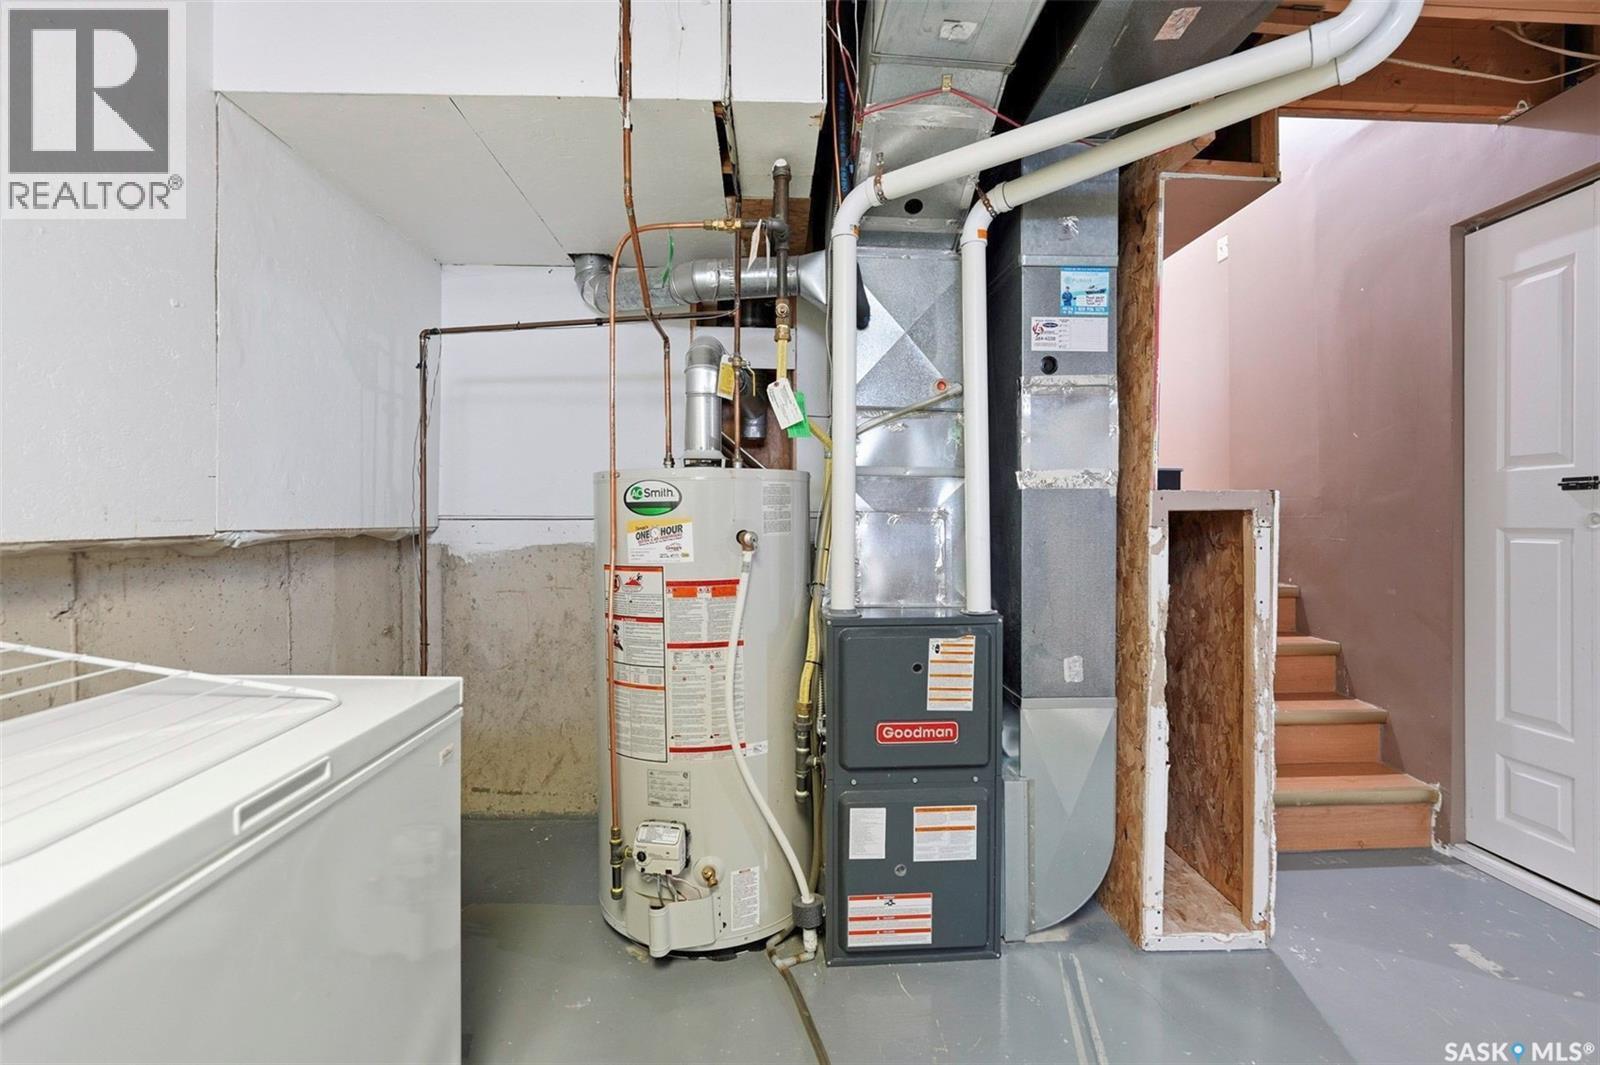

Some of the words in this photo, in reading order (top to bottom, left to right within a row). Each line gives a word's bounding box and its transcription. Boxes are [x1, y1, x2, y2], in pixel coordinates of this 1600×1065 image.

[644, 488, 673, 498] Smith
[636, 530, 650, 540] ONE
[660, 524, 683, 536] HOUR
[882, 726, 953, 739] Goodman
